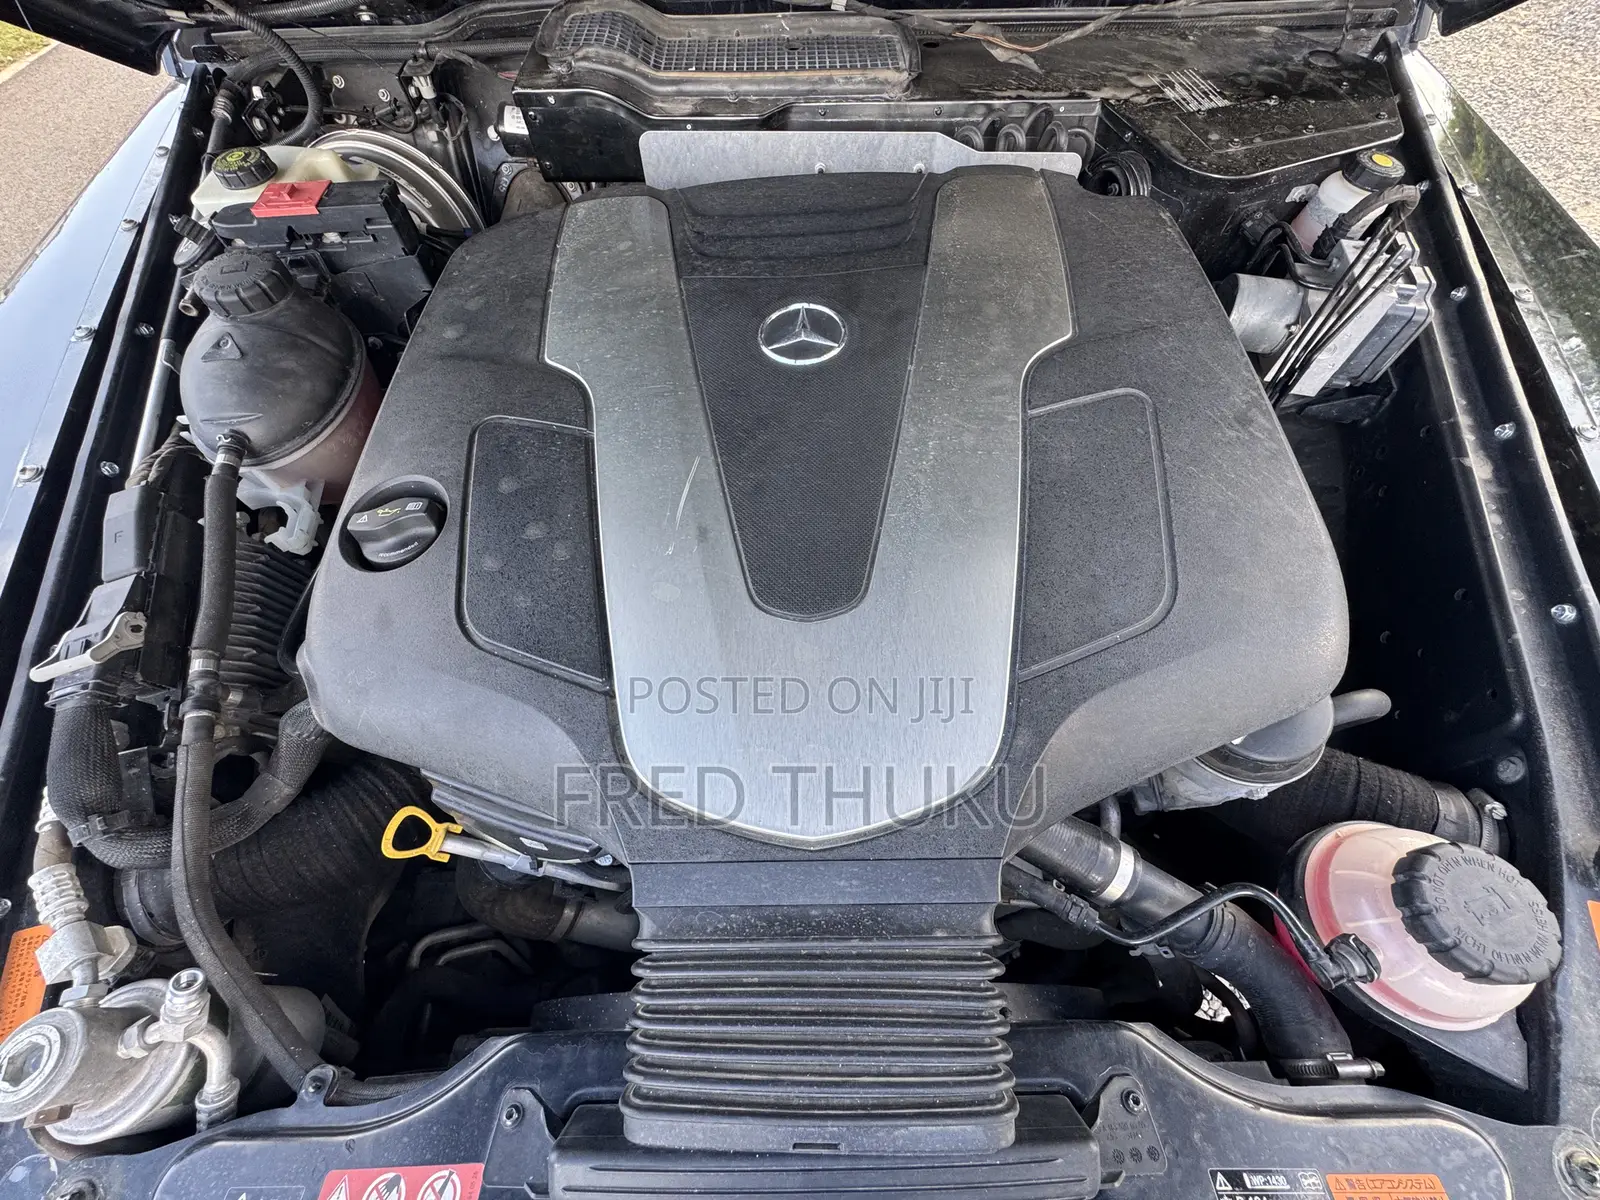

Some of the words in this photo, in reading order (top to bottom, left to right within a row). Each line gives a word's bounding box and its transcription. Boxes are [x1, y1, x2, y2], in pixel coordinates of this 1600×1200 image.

[1461, 855, 1495, 873] WHEN
[1498, 867, 1524, 888] HOT
[1453, 925, 1487, 955] NICHT
